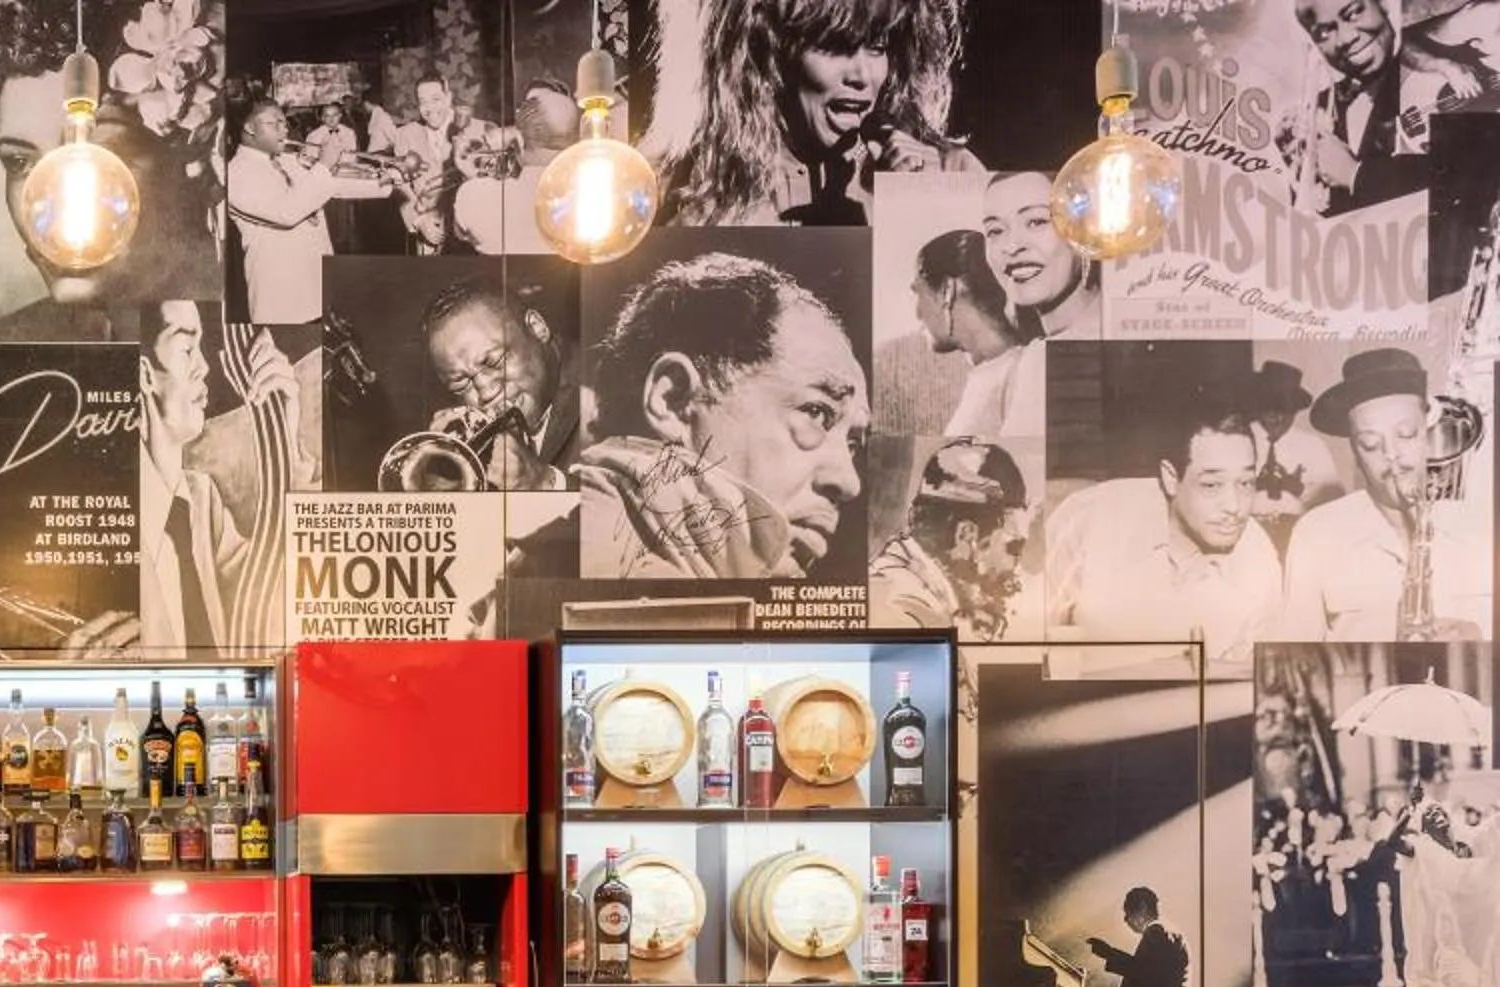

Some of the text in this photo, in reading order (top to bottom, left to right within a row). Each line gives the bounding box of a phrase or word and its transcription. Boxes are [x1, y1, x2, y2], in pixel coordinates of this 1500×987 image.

[87, 391, 131, 403] MILES
[29, 495, 131, 509] AT THE ROYAL
[294, 503, 457, 515] THE JAZZ BAR AT PARIMA
[45, 514, 136, 527] ROOST 1948
[297, 517, 453, 529] PRESENTS A TRIBUTE TO
[35, 533, 131, 546] AT BIRDLAND
[292, 531, 458, 553] THELONIOUS
[295, 555, 458, 600] MONK
[770, 586, 867, 600] THE COMPLETE
[295, 601, 457, 616] FEATURING VOCALIST
[755, 603, 866, 617] DEAN BENEDETTI
[301, 617, 451, 636] MATT WRIGHT
